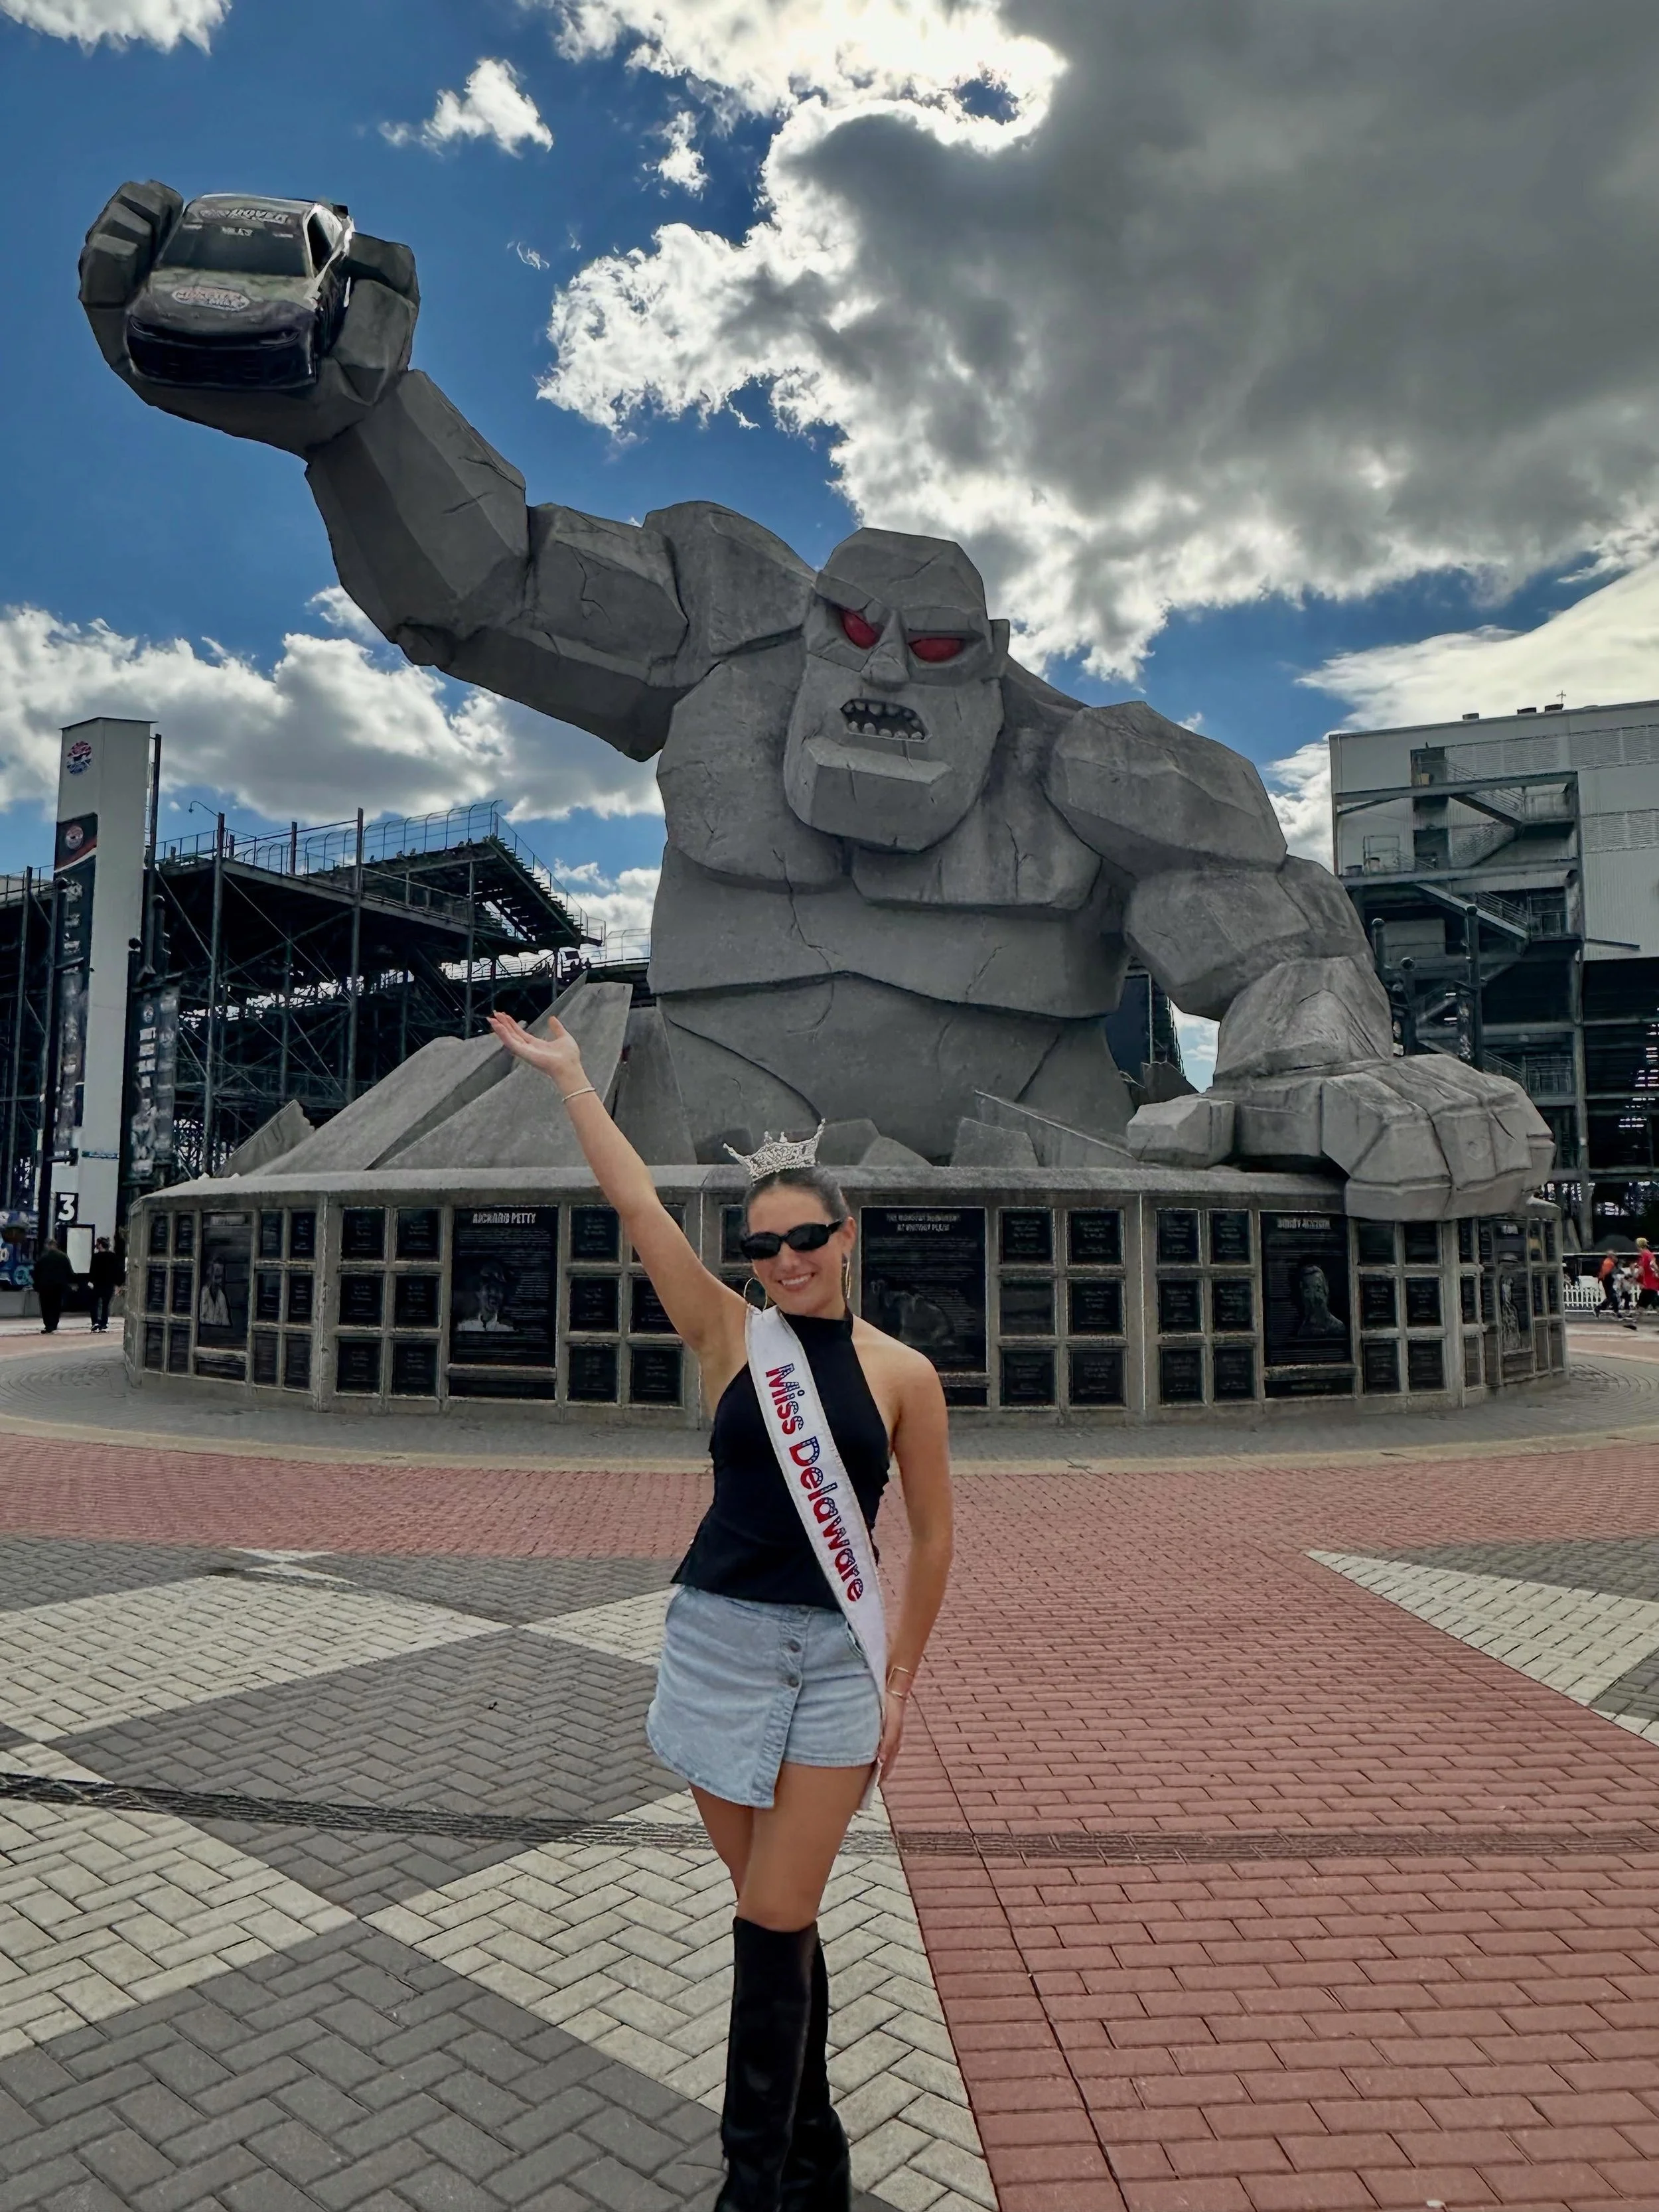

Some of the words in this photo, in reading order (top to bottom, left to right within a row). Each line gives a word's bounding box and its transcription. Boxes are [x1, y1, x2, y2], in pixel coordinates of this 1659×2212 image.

[58, 1193, 75, 1221] 3
[511, 1212, 536, 1224] PETTY
[765, 1363, 805, 1436] Miss
[788, 1436, 864, 1602] Delaware
